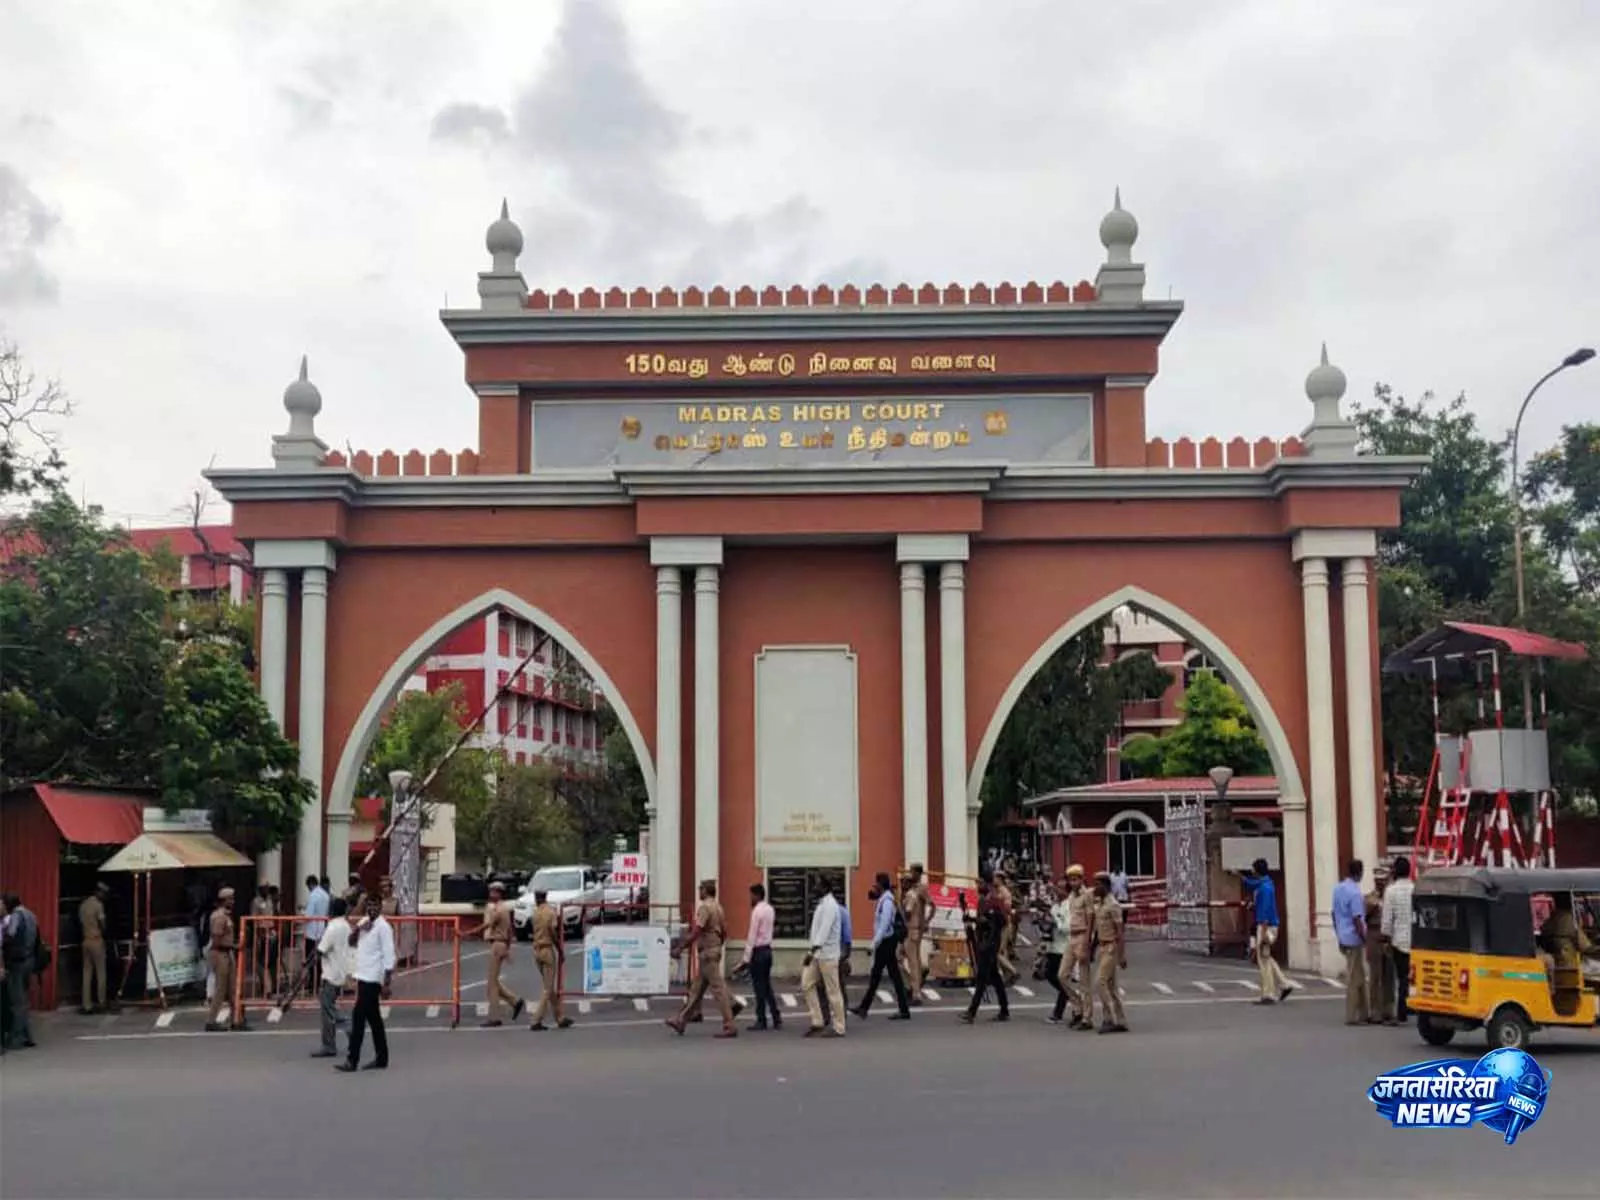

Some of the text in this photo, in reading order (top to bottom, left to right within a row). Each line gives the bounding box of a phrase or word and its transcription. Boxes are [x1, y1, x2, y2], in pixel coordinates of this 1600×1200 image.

[625, 352, 996, 378] 150வது ஆண்டு நினைவு வளைவு
[678, 403, 945, 422] MADRAS HIGH COURT
[623, 856, 638, 868] NO
[614, 872, 646, 883] ENTRY
